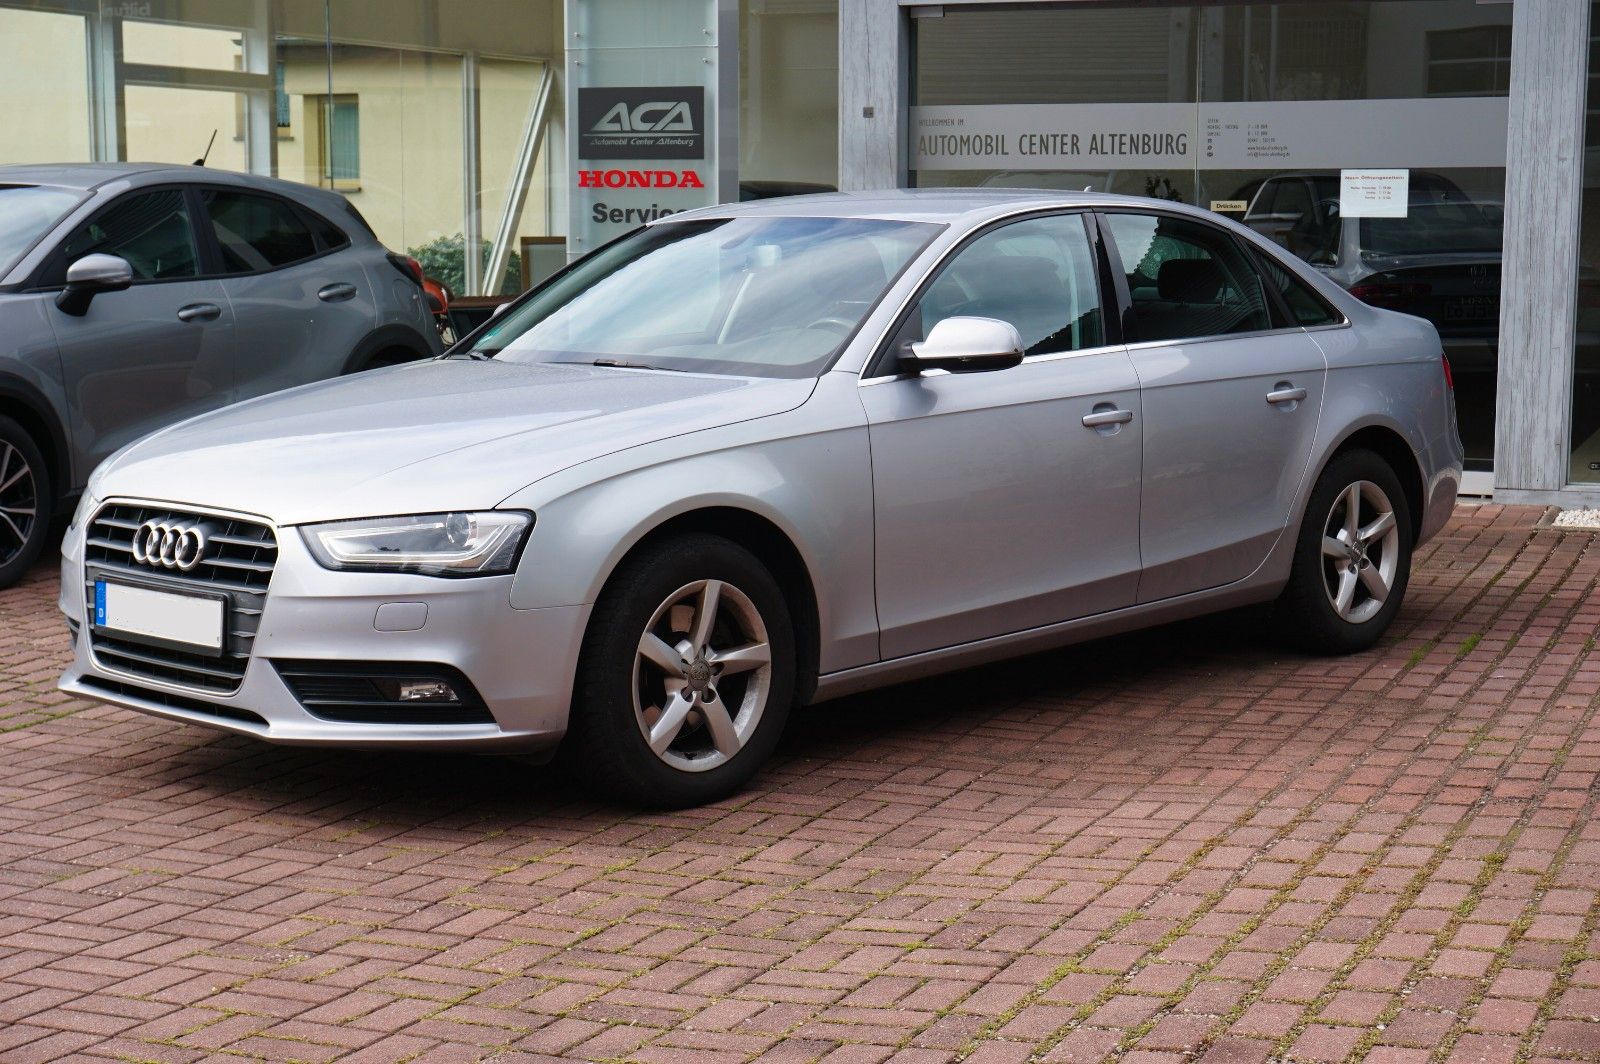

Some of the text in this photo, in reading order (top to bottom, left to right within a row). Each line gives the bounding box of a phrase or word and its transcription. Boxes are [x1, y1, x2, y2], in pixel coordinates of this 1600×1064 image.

[590, 101, 694, 131] ACA
[656, 138, 694, 147] Altenburg
[918, 133, 1188, 156] AUTOMOBIL CENTER ALTENBURG
[578, 170, 705, 189] HONDA
[592, 203, 688, 224] Servic
